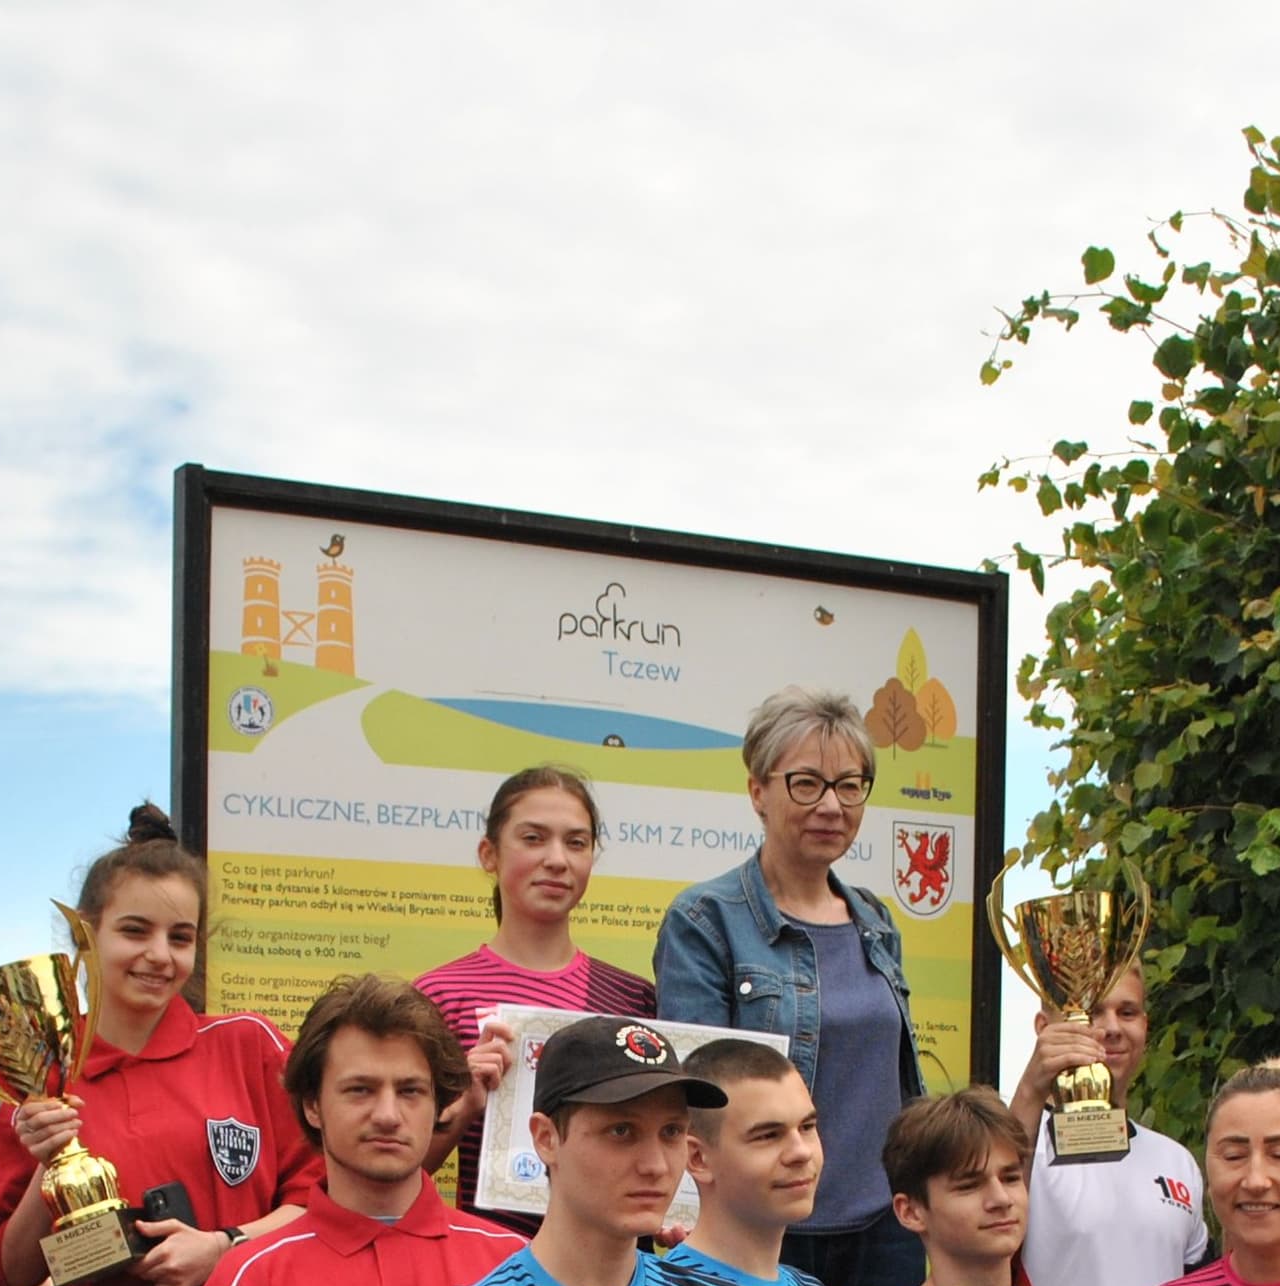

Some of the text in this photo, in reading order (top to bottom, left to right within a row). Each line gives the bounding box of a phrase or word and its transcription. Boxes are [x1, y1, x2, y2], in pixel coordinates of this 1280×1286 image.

[558, 582, 681, 647] parkrun
[601, 650, 681, 682] Tczew
[222, 793, 488, 831] CYKLICZNE, BEZPŁATN
[618, 823, 662, 846] 5KM
[671, 827, 685, 847] Z
[691, 829, 765, 852] POMIA
[222, 862, 336, 880] Co to jest parkrun?
[222, 878, 234, 889] To
[237, 880, 258, 893] bieg
[261, 882, 272, 892] na
[275, 883, 320, 895] dystansie
[323, 884, 329, 894] 5
[332, 885, 388, 898] kilometrów
[399, 889, 447, 901] pomiarem
[449, 893, 475, 903] czasu
[222, 894, 266, 908] Pierwszy
[268, 896, 308, 909] parkrun
[367, 901, 406, 916] Wielkiej
[221, 926, 391, 948] Kiedy organizowany jest bieg?
[221, 972, 256, 986] Gdzie
[221, 989, 246, 1001] Start
[254, 992, 280, 1002] meta
